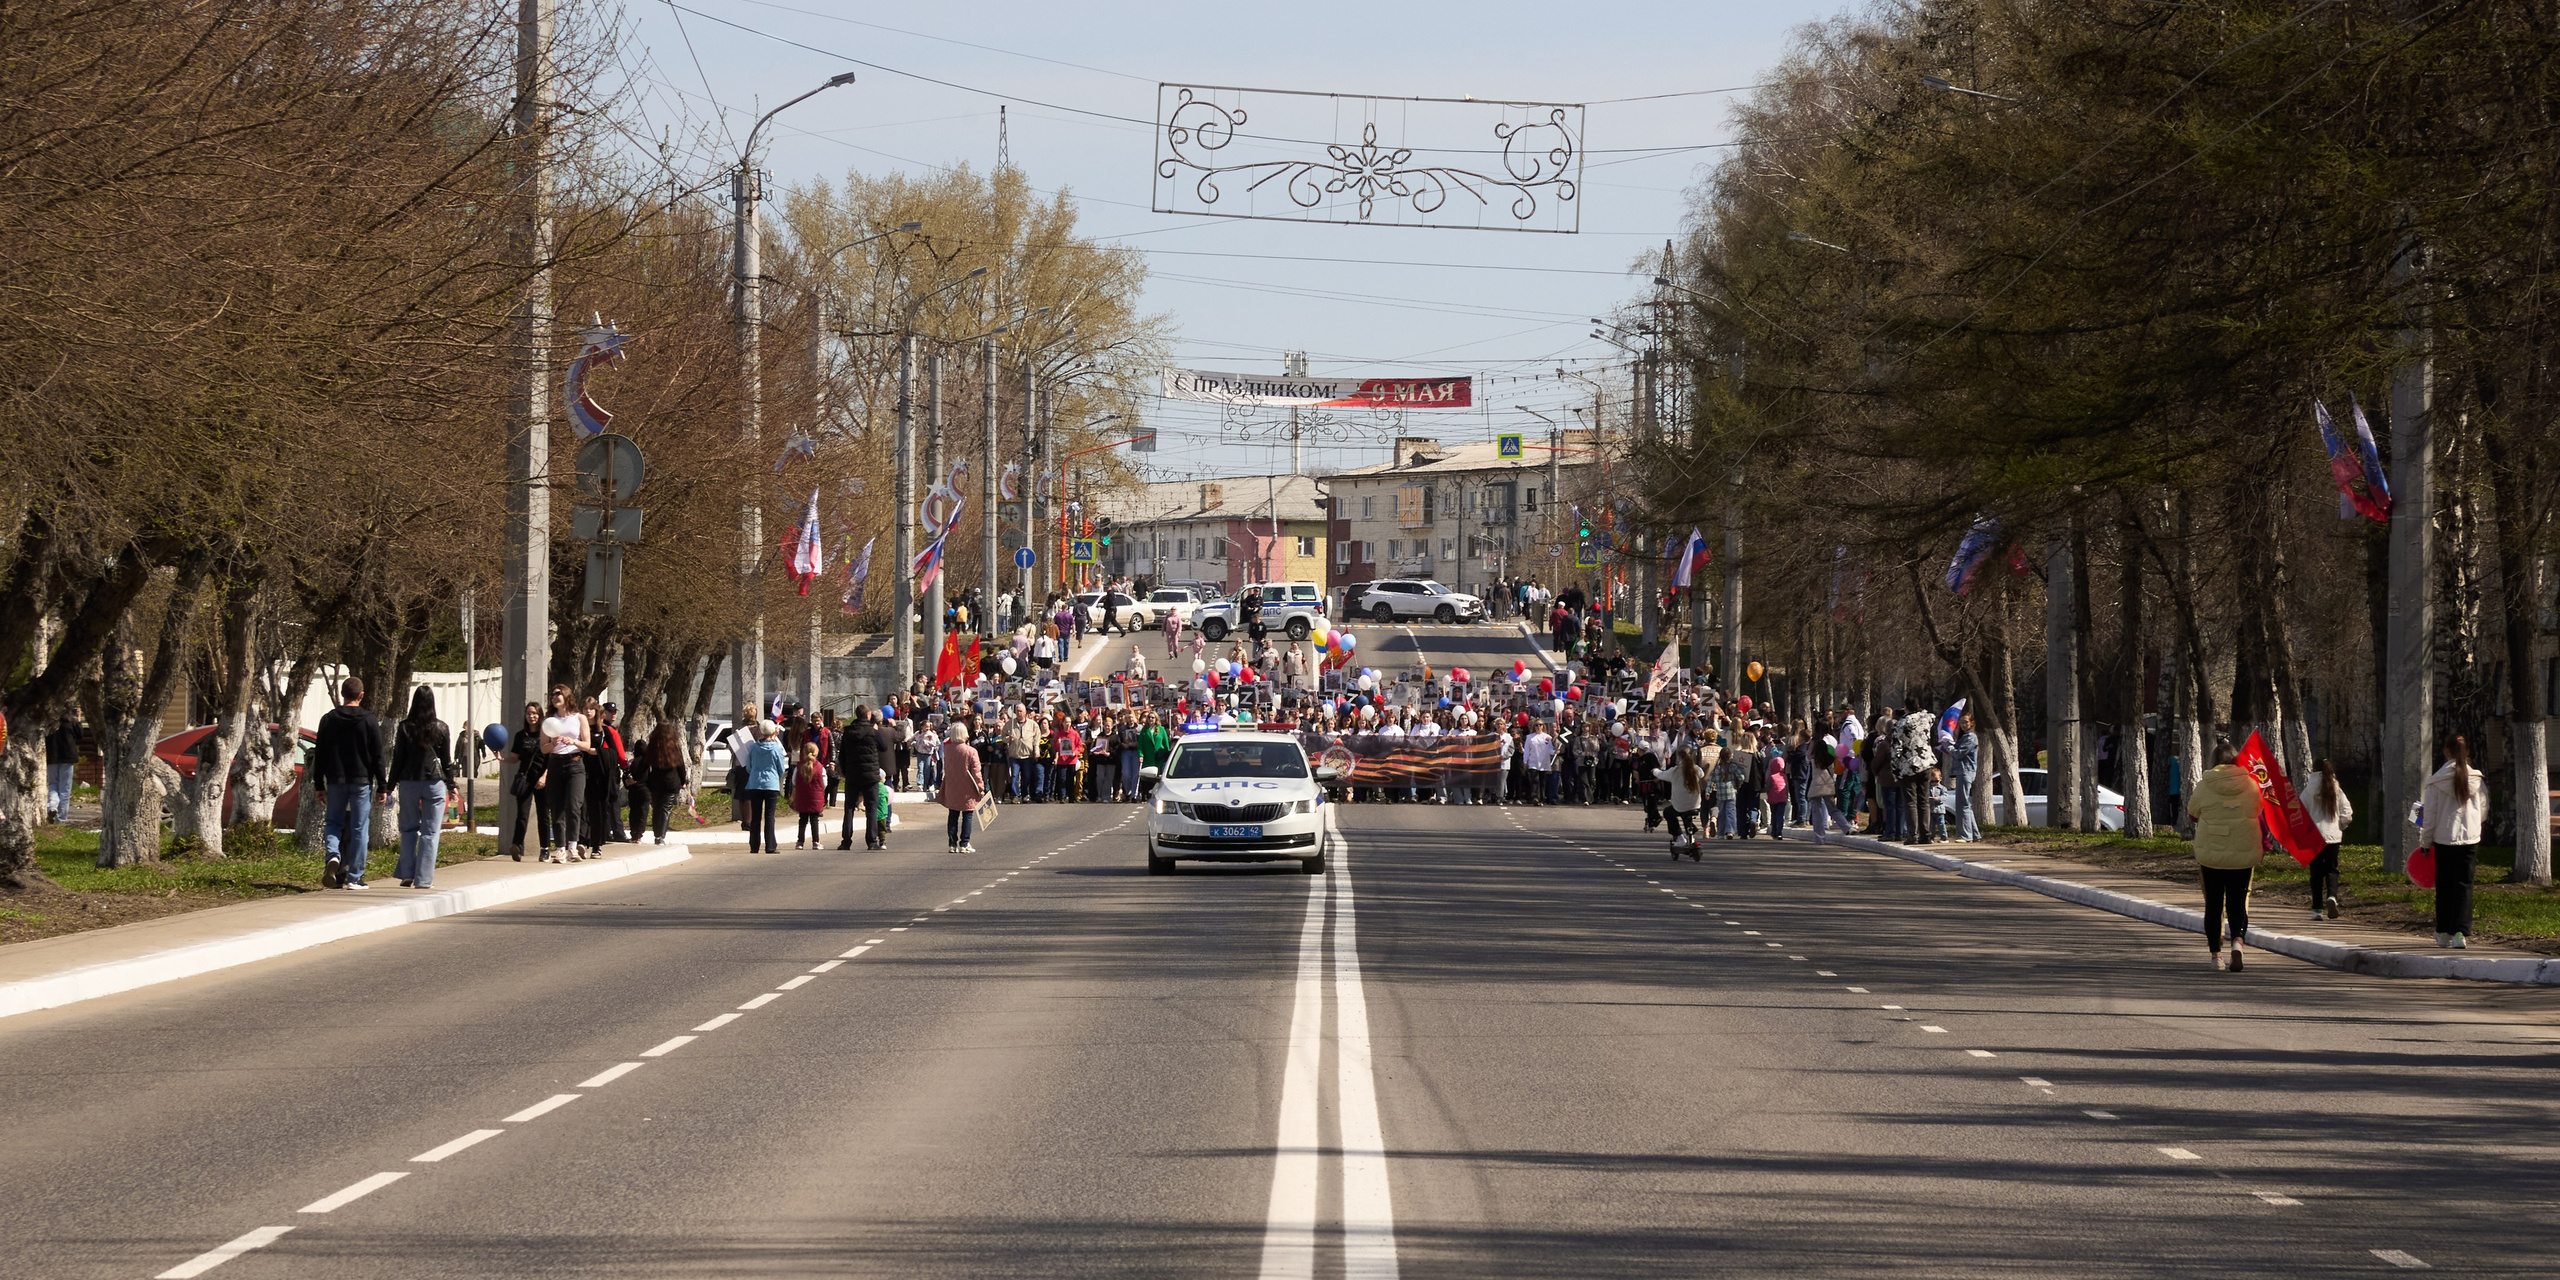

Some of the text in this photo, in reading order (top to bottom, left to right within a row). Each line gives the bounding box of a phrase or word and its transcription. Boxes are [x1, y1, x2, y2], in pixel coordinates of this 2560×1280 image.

[1174, 375, 1456, 402] С ПРАЗДНИКОМ! 9 МАЯ
[1550, 545, 1560, 553] 25
[1263, 607, 1282, 617] ДПС
[1623, 681, 1635, 693] Z
[1026, 697, 1038, 710] Z
[1046, 692, 1059, 705] Z
[1241, 691, 1254, 705] Z
[1701, 693, 1714, 707] Z
[1627, 700, 1640, 713] Z
[1560, 726, 1573, 743] Z
[1191, 781, 1279, 792] ДПС
[1222, 827, 1245, 836] 3062
